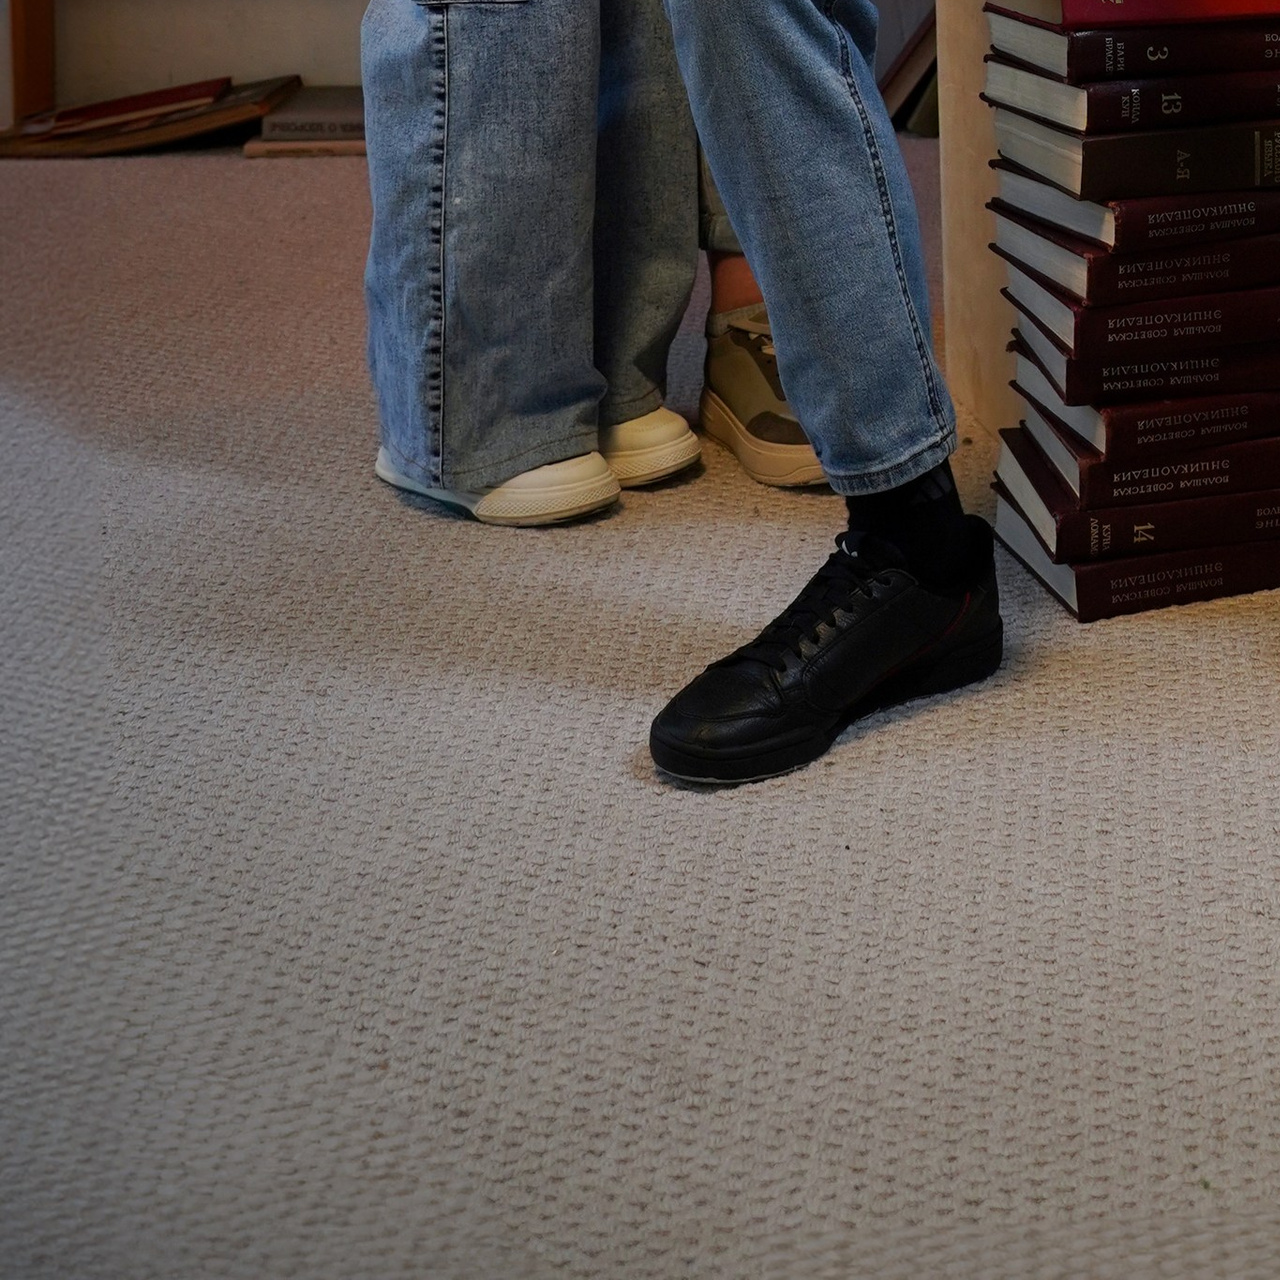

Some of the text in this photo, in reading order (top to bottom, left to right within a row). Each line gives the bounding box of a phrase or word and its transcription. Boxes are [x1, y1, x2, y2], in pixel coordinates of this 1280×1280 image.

[1116, 41, 1125, 72] БАРИ
[1147, 45, 1169, 61] 3
[1120, 94, 1130, 119] КУН
[1160, 91, 1183, 115] 13
[1147, 202, 1257, 223] ЭНЦИКЛОПЕДИЯ
[1147, 217, 1256, 239] БОЛЬШАЯ СОВЕТСКАЯ
[1117, 253, 1231, 275] ЭНЦИКЛОПЕДИЯ
[1117, 269, 1230, 289] БОЛЬШАЯ СОВЕТСКАЯ
[1107, 309, 1223, 329] ЭНЦИКЛОПЕДИЯ
[1107, 324, 1222, 343] БОЛЬШАЯ СОВЕТСКАЯ
[1102, 358, 1221, 377] ЭНЦИКЛОПЕДИЯ
[1102, 372, 1220, 392] БОЛЬШАЯ СОВЕТСКАЯ
[1136, 406, 1249, 431] ЭНЦИКЛОПЕДИЯ
[1136, 421, 1248, 445] БОЛЬШАЯ СОВЕТСКАЯ
[1112, 459, 1230, 483] ЭНЦИКЛОПЕДИЯ
[1112, 475, 1230, 497] БОЛЬШАЯ СОВЕТСКАЯ
[1133, 521, 1155, 544] 14
[1110, 563, 1224, 589] ЭНЦИКЛОПЕДИЯ
[1110, 578, 1224, 604] БОЛЬШАЯ СОВЕТСКАЯ
